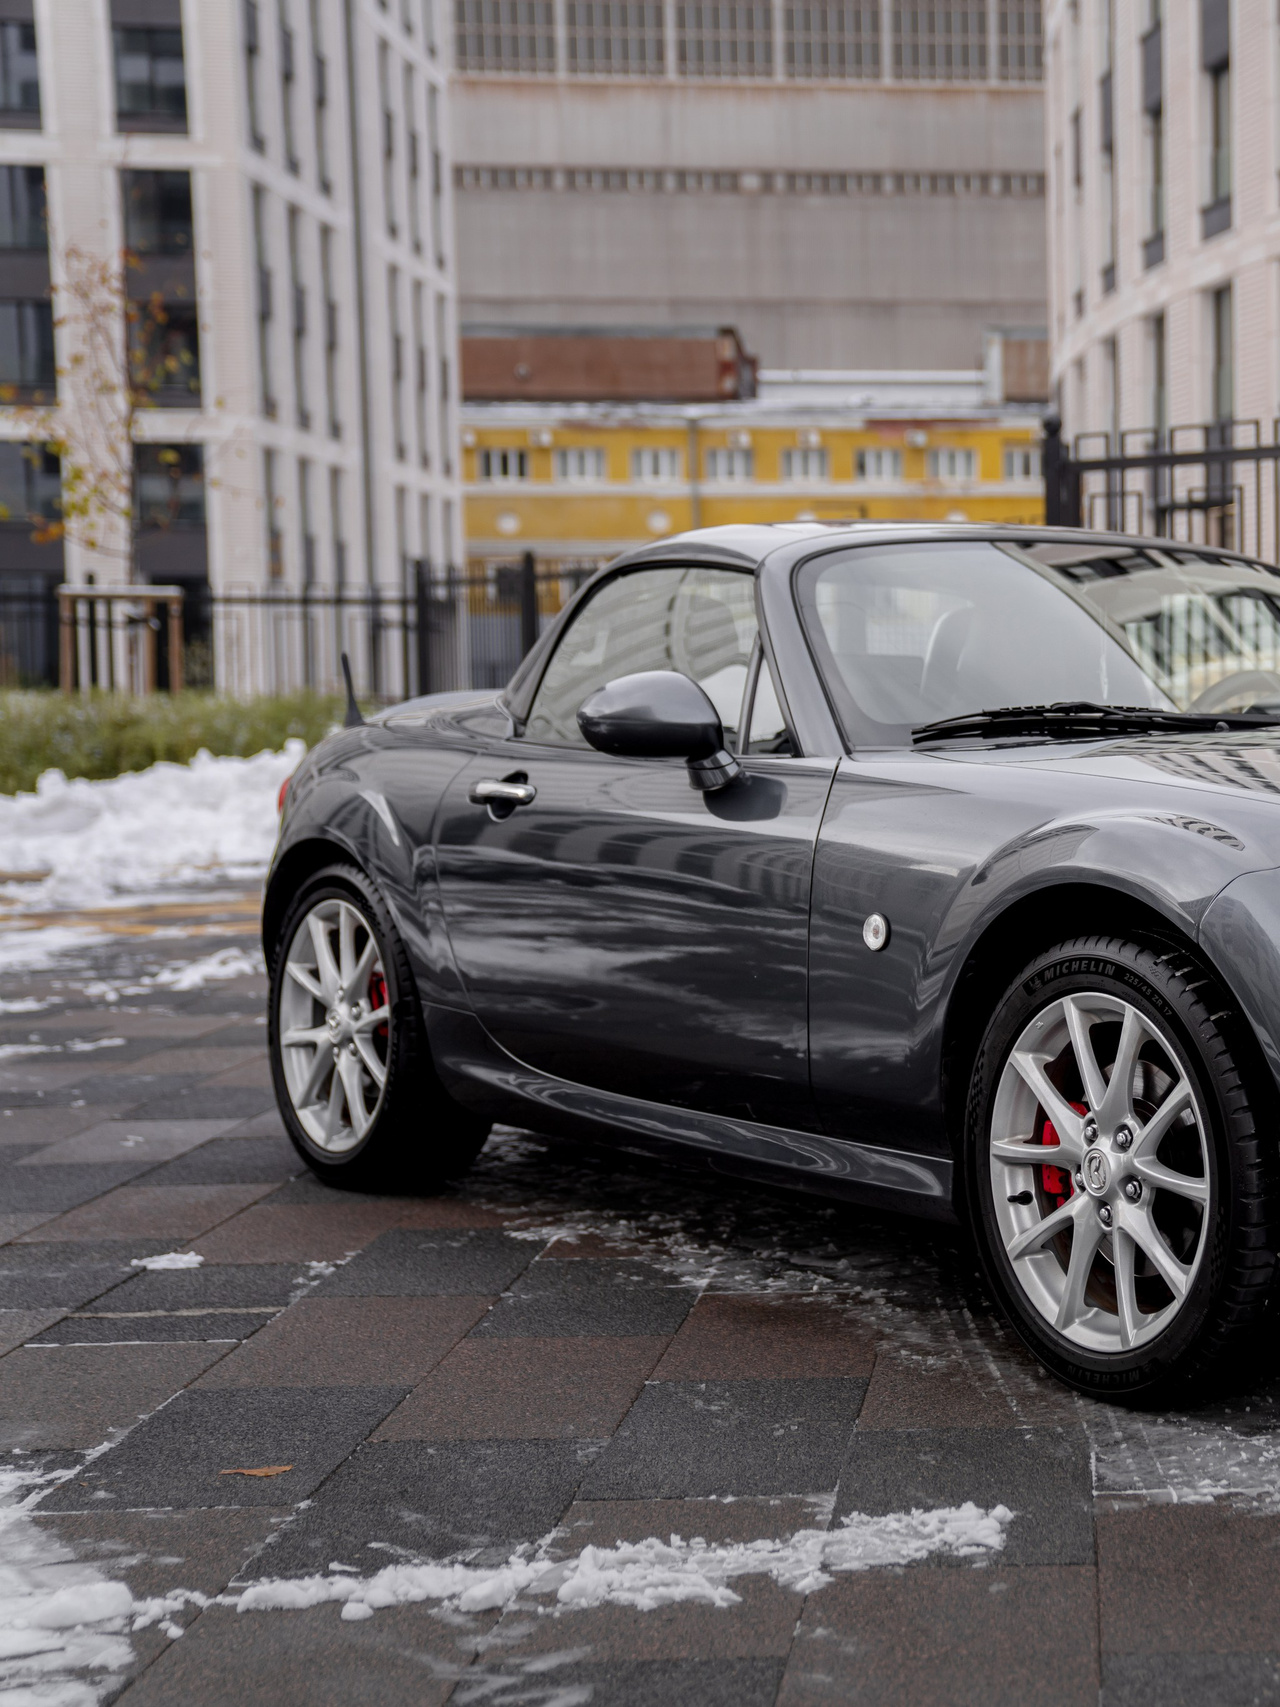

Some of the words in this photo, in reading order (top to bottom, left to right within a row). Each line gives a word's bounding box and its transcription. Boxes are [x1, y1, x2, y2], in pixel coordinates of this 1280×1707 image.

[1044, 960, 1116, 983] MICHELIN
[1124, 972, 1152, 997] 225/45
[1151, 994, 1163, 1007] ZR
[1163, 1005, 1173, 1017] 17
[1067, 1364, 1140, 1384] MICHELIN
